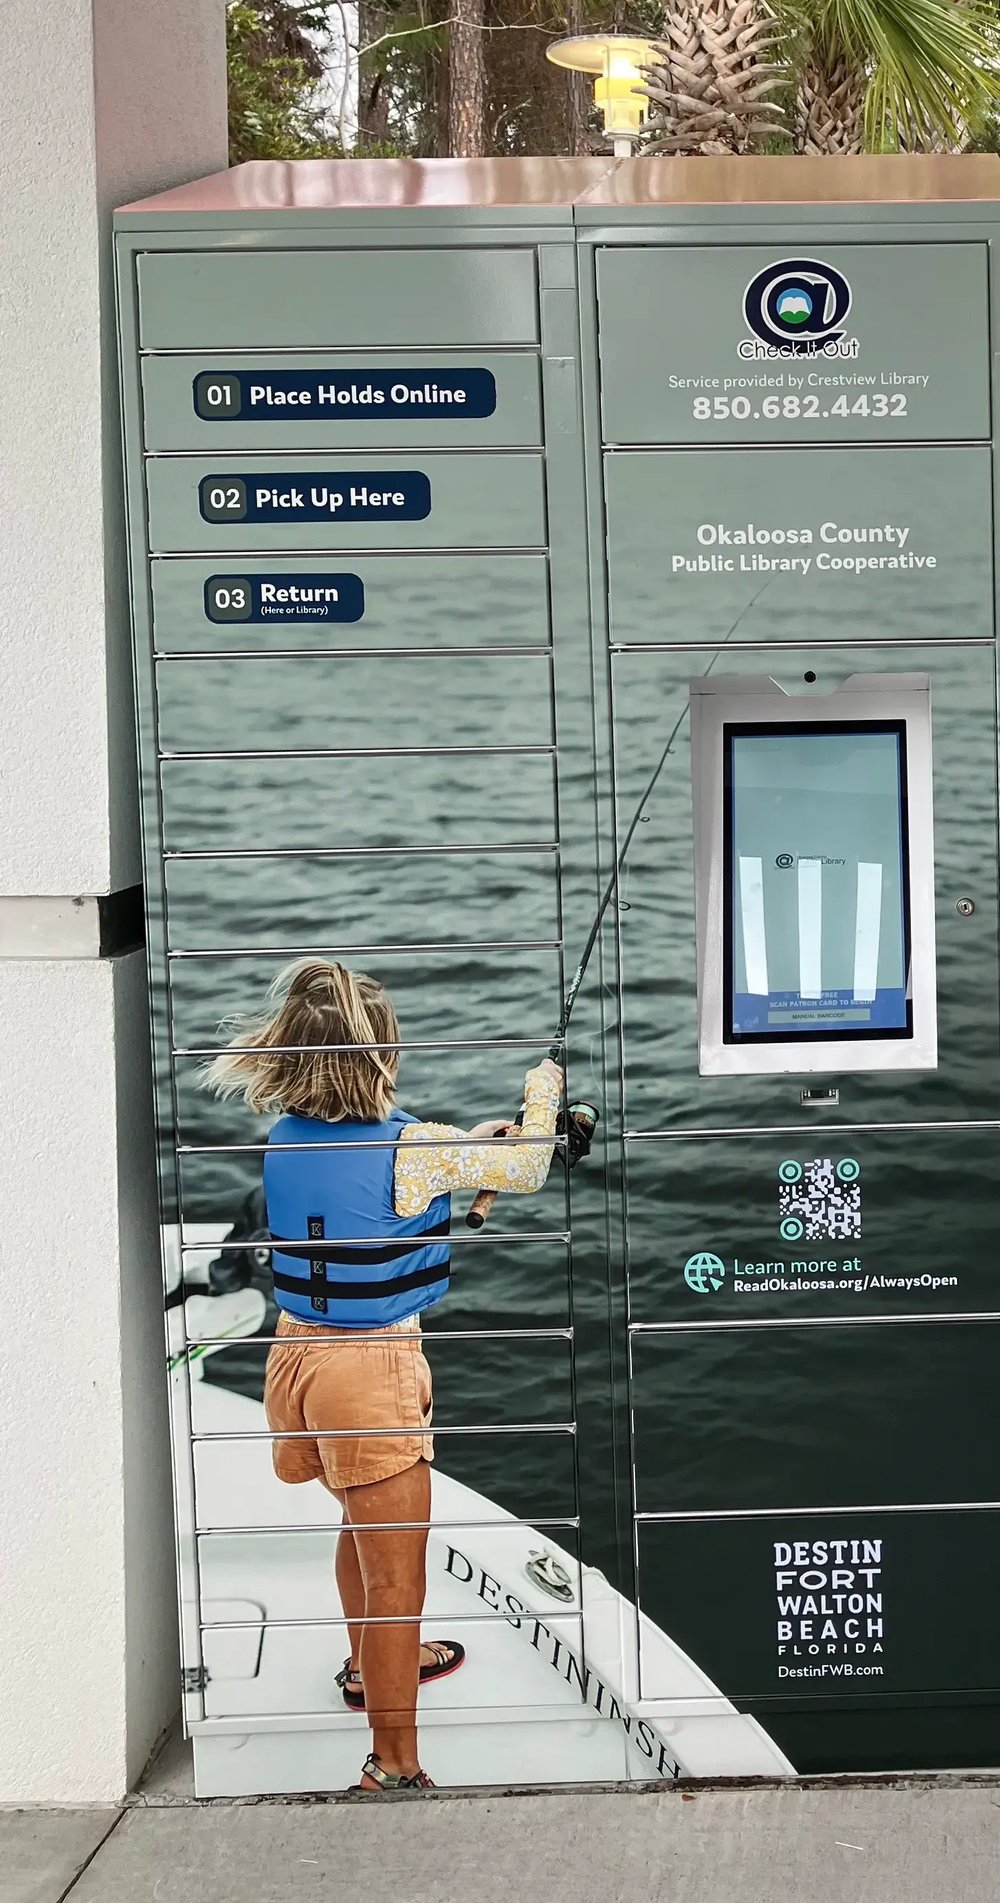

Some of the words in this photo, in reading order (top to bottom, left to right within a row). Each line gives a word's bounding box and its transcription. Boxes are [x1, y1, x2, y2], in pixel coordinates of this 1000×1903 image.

[739, 341, 801, 358] Check
[806, 341, 818, 357] It
[823, 340, 859, 357] Out
[668, 375, 720, 388] Service
[724, 374, 784, 390] provided
[788, 374, 804, 389] by
[807, 373, 877, 386] Crestview
[881, 372, 929, 388] Library
[207, 385, 231, 405] 01
[250, 386, 311, 405] Place
[318, 385, 385, 404] Holds
[390, 384, 466, 404] Online
[692, 394, 908, 420] 850.682.4432
[209, 488, 241, 508] 02
[255, 488, 304, 508] Pick
[310, 488, 343, 512] Up
[350, 487, 405, 506] Here
[697, 524, 813, 545] Okaloosa
[820, 522, 910, 548] County
[672, 554, 734, 572] Public
[740, 554, 811, 574] Library
[816, 552, 937, 574] Cooperative
[215, 588, 245, 608] 03
[260, 583, 339, 602] Return
[261, 606, 284, 616] (Here
[296, 605, 329, 616] Library)
[733, 1259, 785, 1275] Learn
[791, 1261, 837, 1273] more
[843, 1257, 861, 1271] at
[734, 1274, 958, 1292] ReadOkaloosa.org/AlwaysOpen
[773, 1540, 883, 1566] DESTIN
[776, 1568, 881, 1591] FORT
[777, 1593, 882, 1616] WALTON
[777, 1618, 883, 1641] BEACH
[778, 1642, 883, 1656] FLORIDA
[777, 1664, 884, 1678] DestinFWB.com
